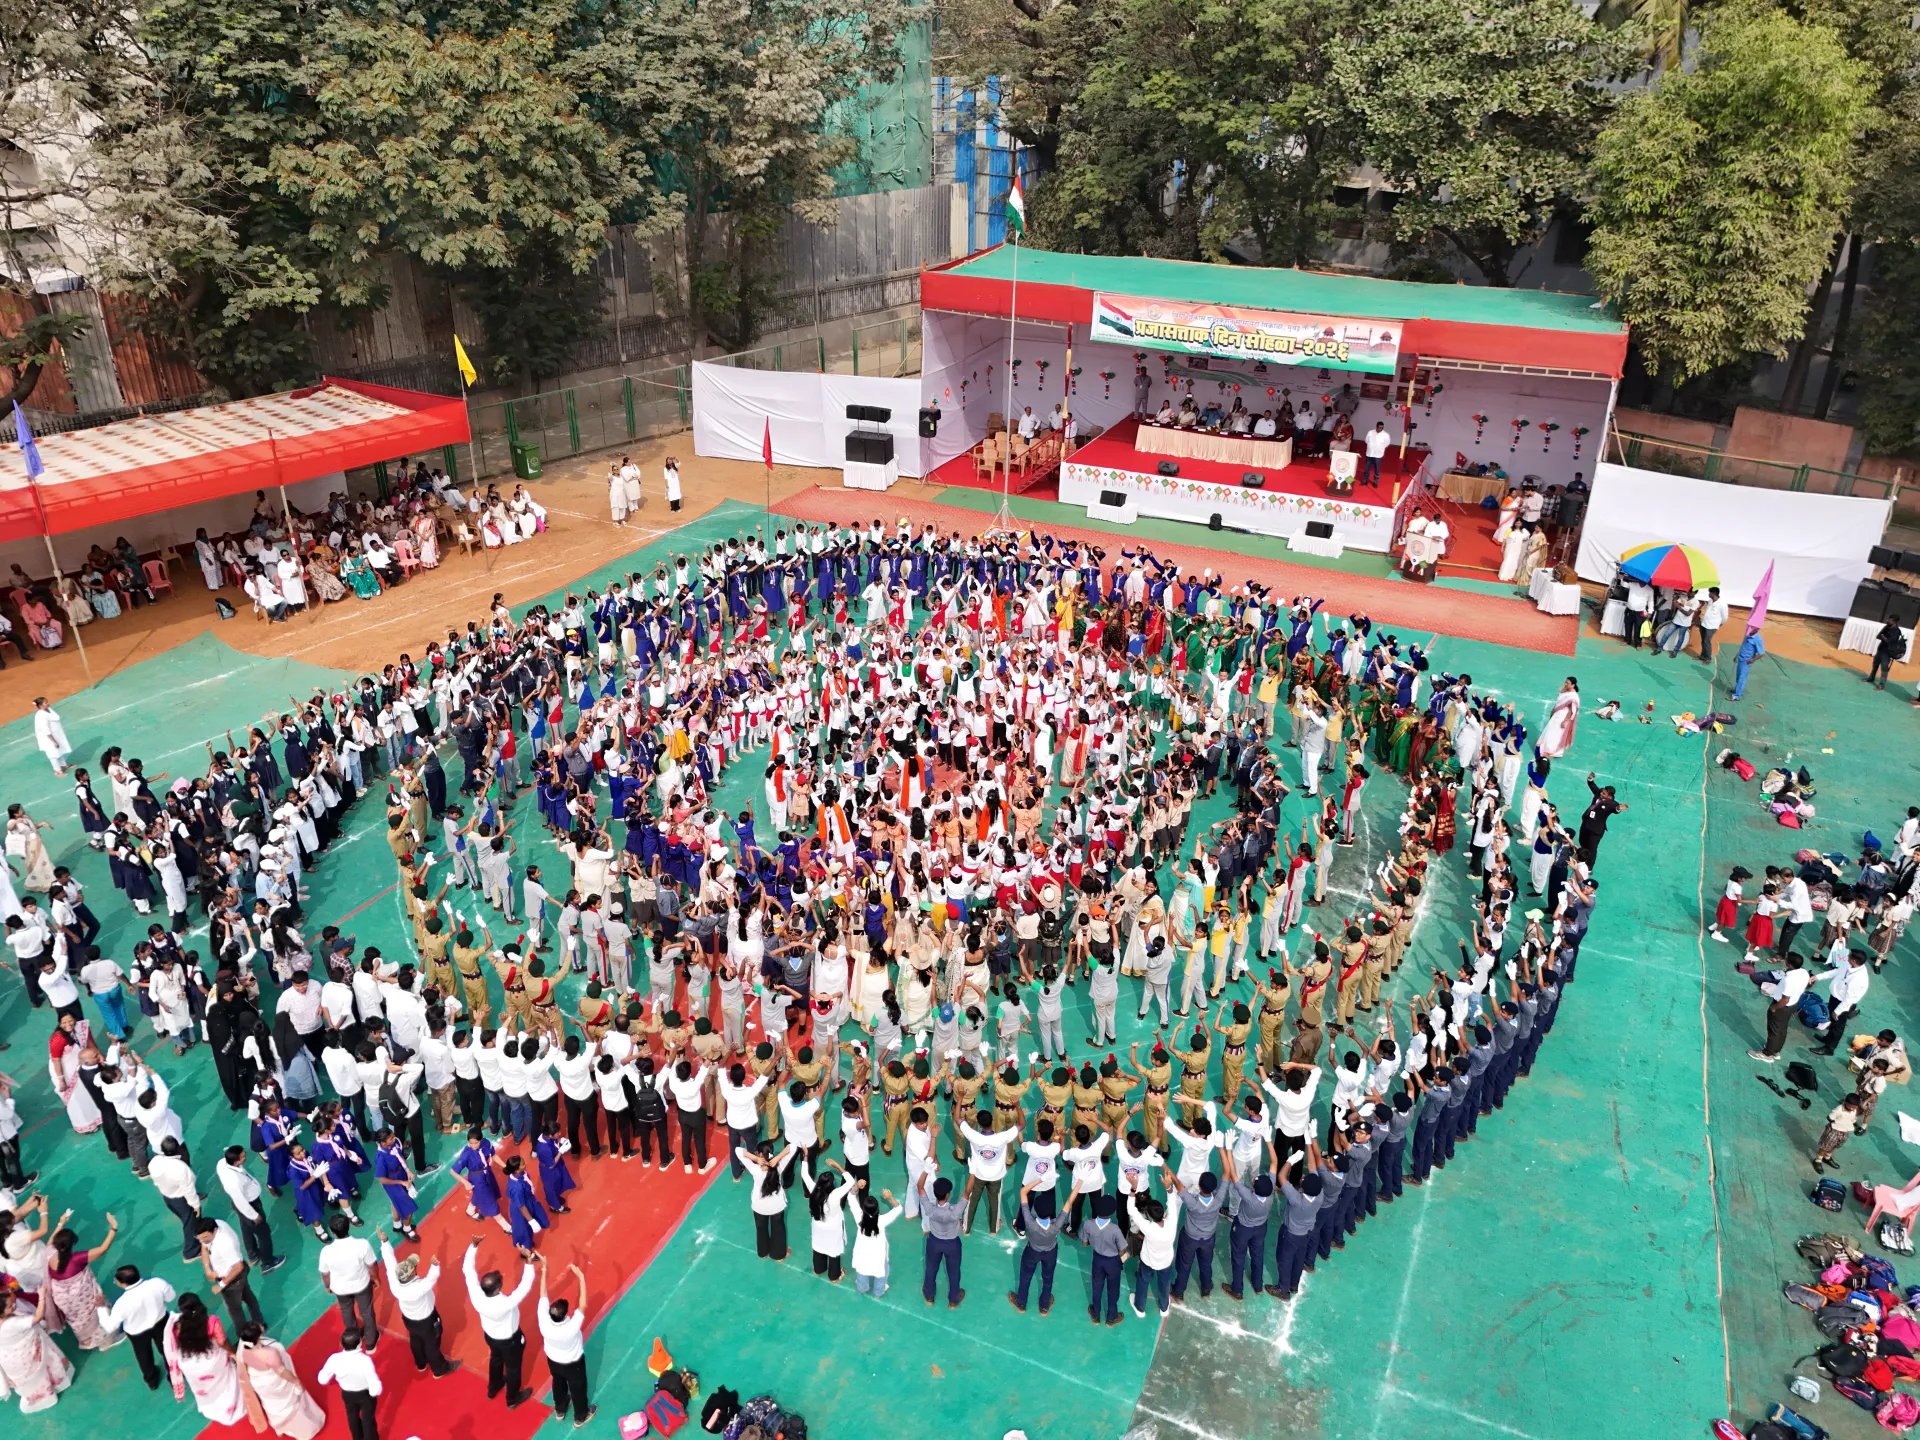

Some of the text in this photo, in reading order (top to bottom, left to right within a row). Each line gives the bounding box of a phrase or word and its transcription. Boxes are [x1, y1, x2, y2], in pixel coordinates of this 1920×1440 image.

[1134, 318, 1211, 346] प्रजासत्ताक
[1213, 324, 1243, 349] दिन
[1244, 328, 1350, 363] सोहळा-२०२६
